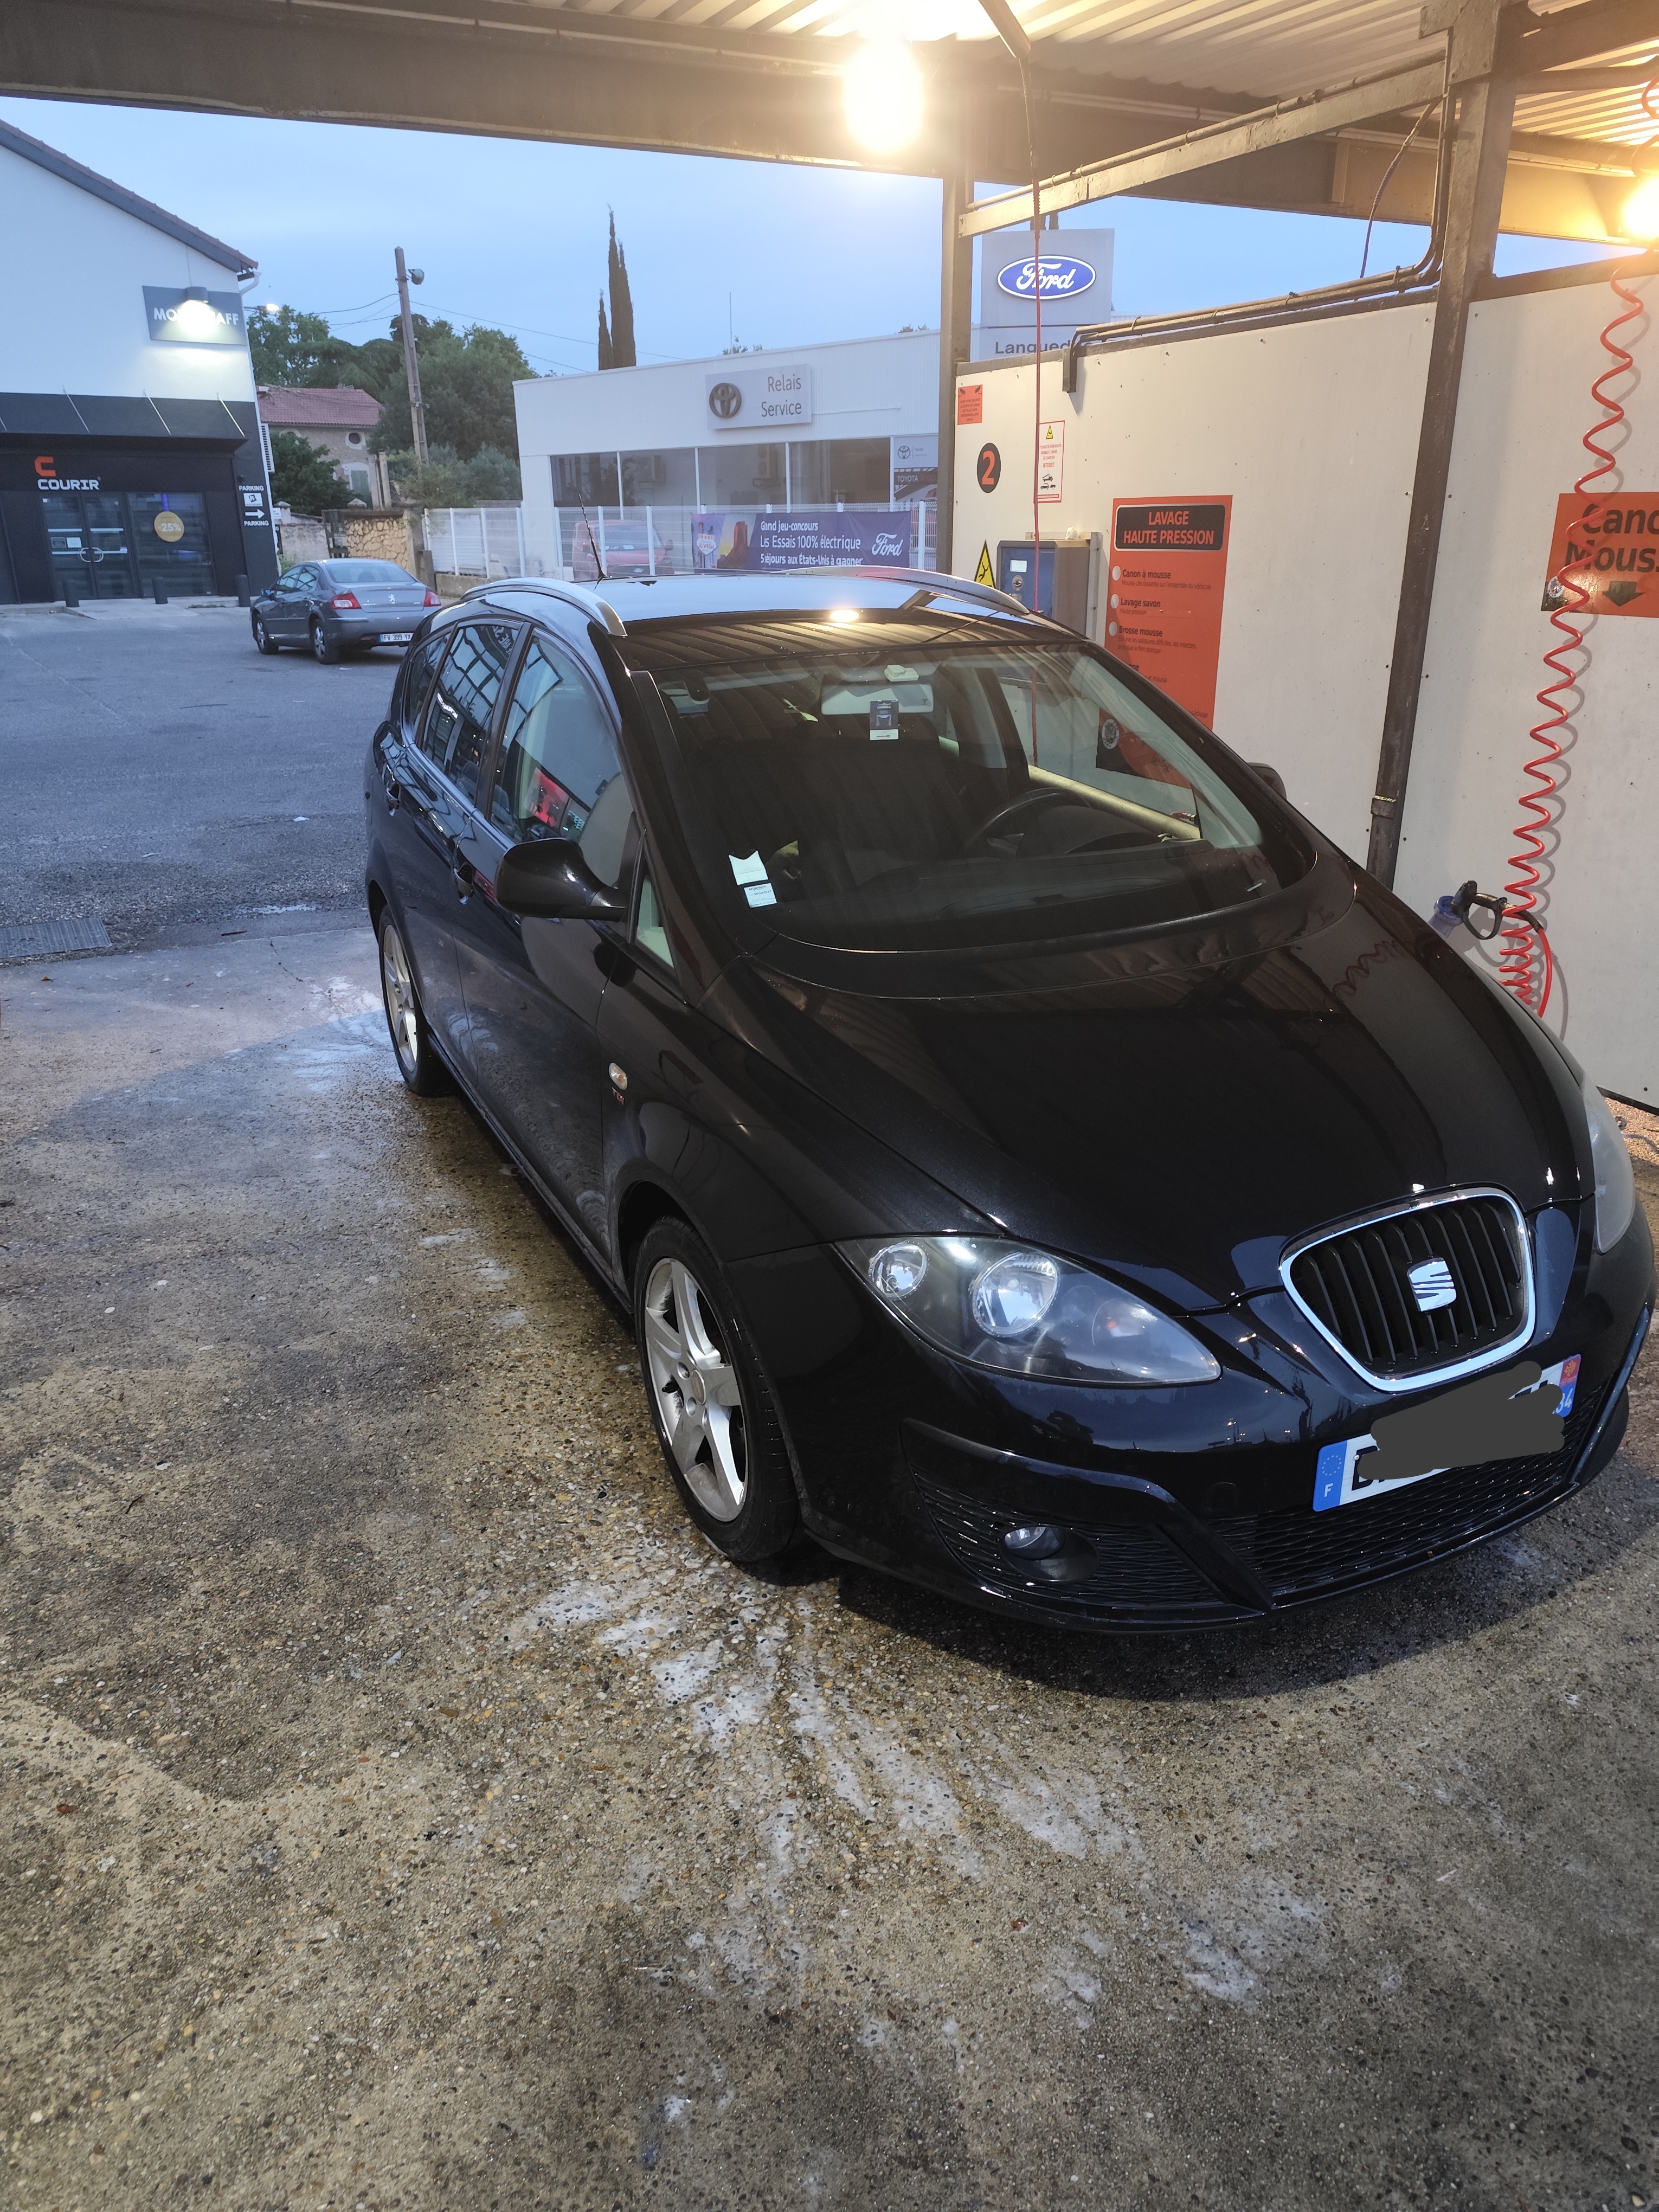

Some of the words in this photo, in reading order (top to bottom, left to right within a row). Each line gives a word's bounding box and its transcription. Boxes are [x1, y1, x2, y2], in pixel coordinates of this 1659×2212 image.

[1016, 263, 1077, 290] Ford
[768, 374, 801, 392] Relais
[761, 399, 802, 417] Service
[982, 450, 995, 485] 2
[37, 479, 100, 490] COURIR
[1148, 511, 1189, 525] LAVAGE
[158, 523, 182, 532] -25%
[777, 520, 818, 533] jeu-concours
[772, 534, 796, 548] Essais
[798, 535, 819, 549] 100%
[820, 534, 861, 552] électrique
[871, 533, 904, 556] Ford
[1123, 530, 1158, 544] HAUTE
[1159, 530, 1215, 545] PRESSION
[761, 553, 764, 563] 5
[787, 556, 798, 564] aux
[799, 552, 830, 565] États-Unis
[831, 554, 835, 565] à
[1122, 569, 1141, 578] Canon
[1142, 569, 1146, 578] à
[1148, 571, 1171, 579] mousse
[1121, 598, 1141, 608] Lavage
[1143, 600, 1161, 608] savon
[1119, 626, 1139, 635] Brosse
[1140, 628, 1163, 637] mousse
[1323, 1483, 1333, 1498] F
